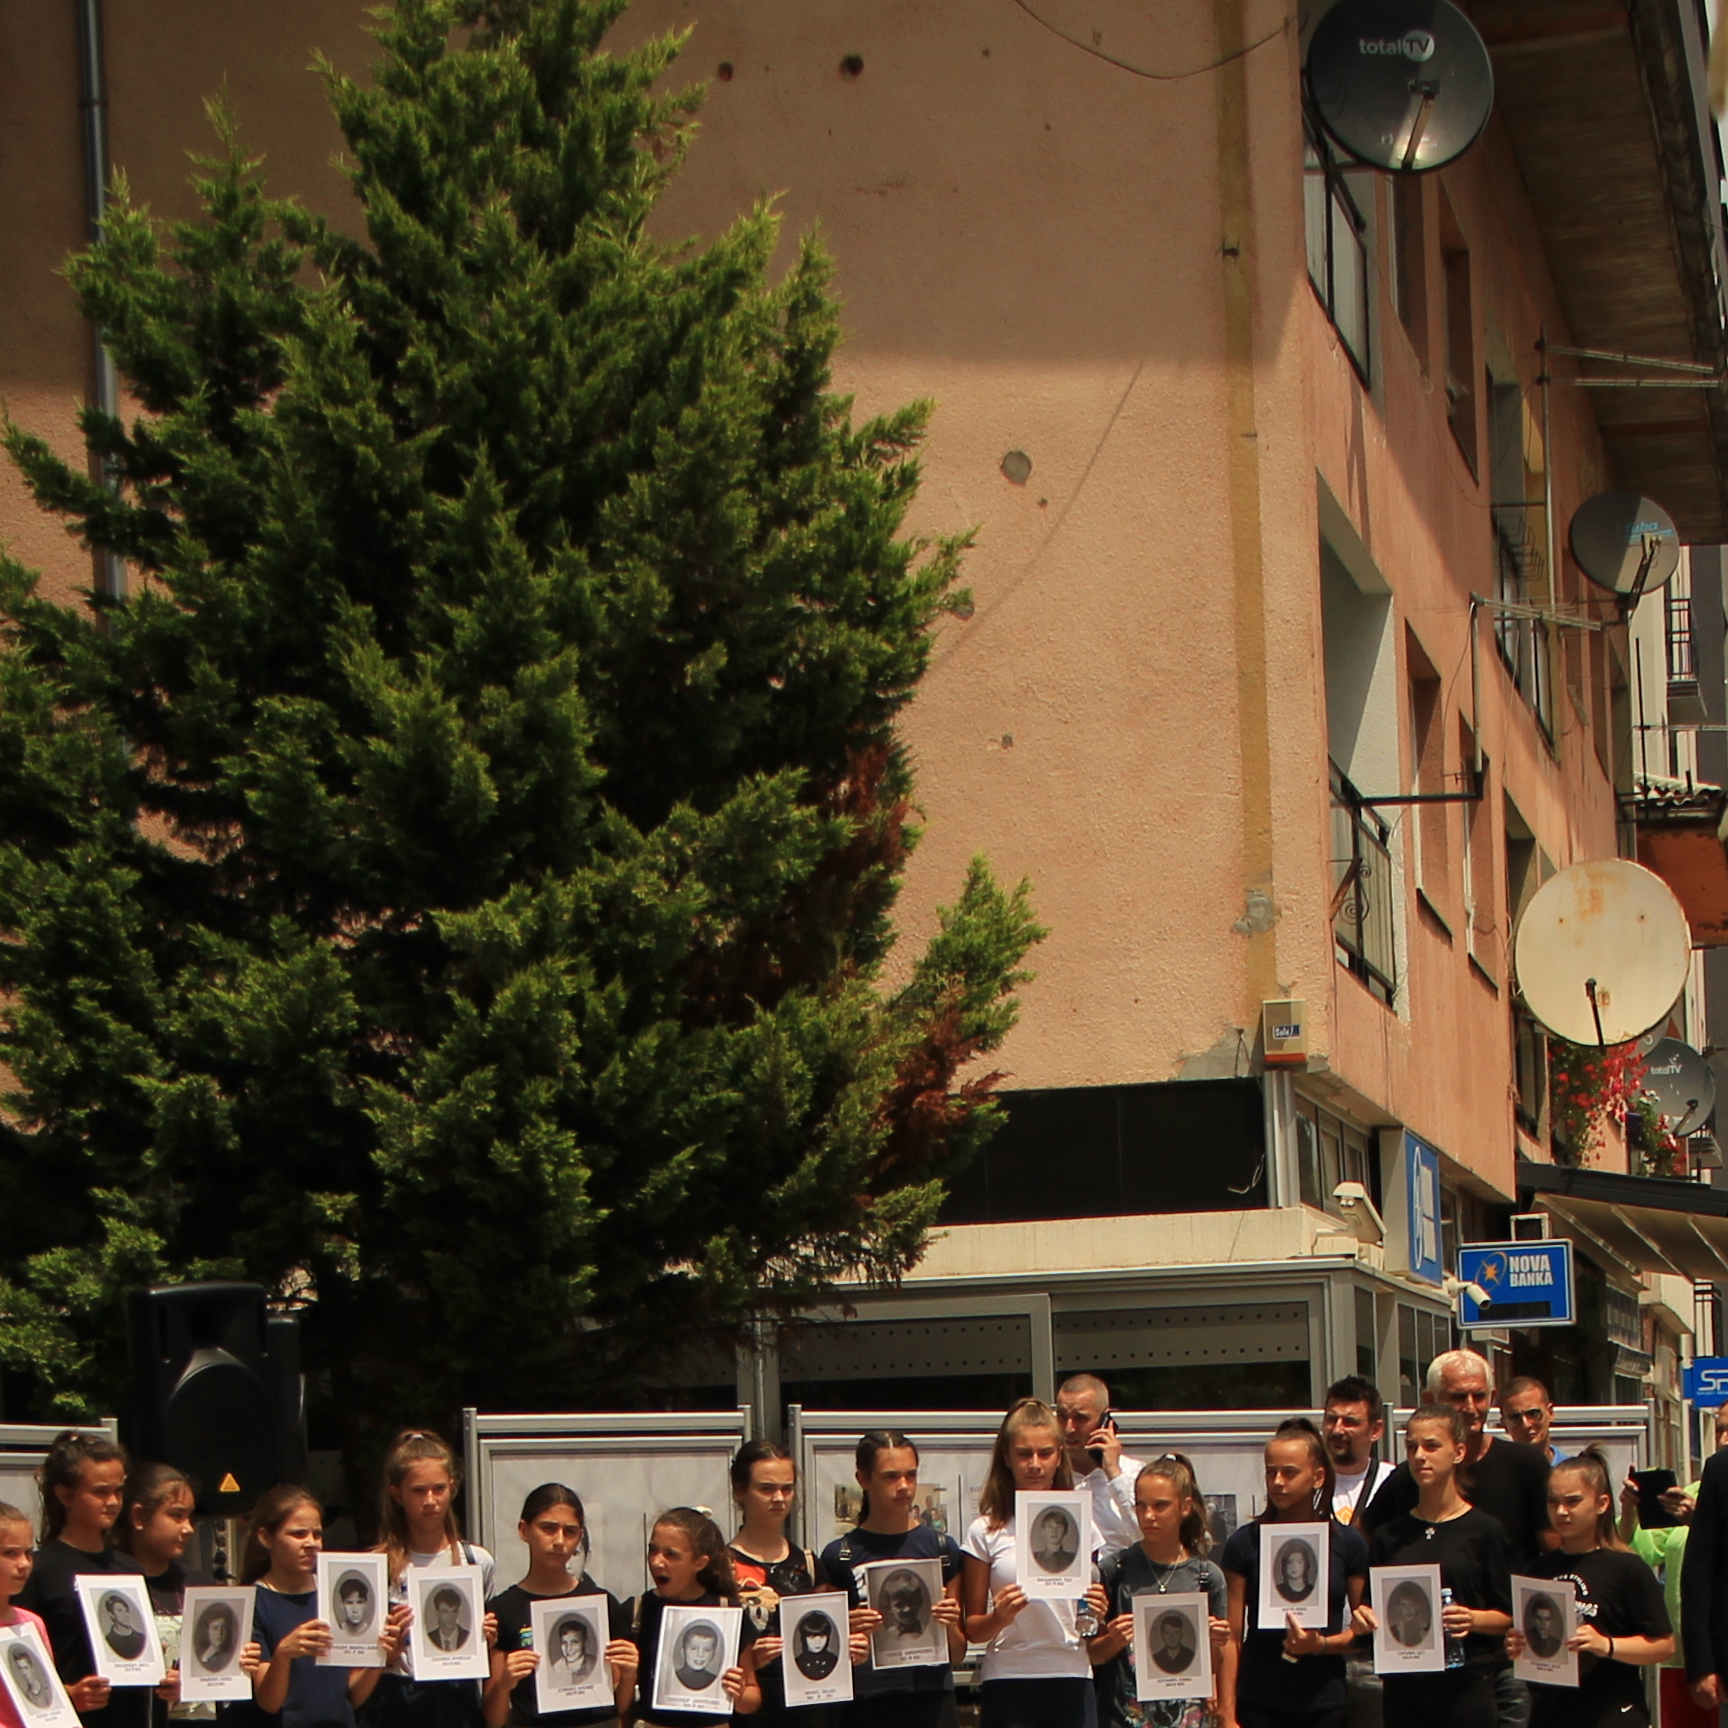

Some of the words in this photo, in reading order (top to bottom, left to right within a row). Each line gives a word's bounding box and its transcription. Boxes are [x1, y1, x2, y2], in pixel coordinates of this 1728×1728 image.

[1358, 36, 1434, 57] totalTV
[1509, 1254, 1551, 1273] NOVA
[1509, 1271, 1553, 1287] BANKA
